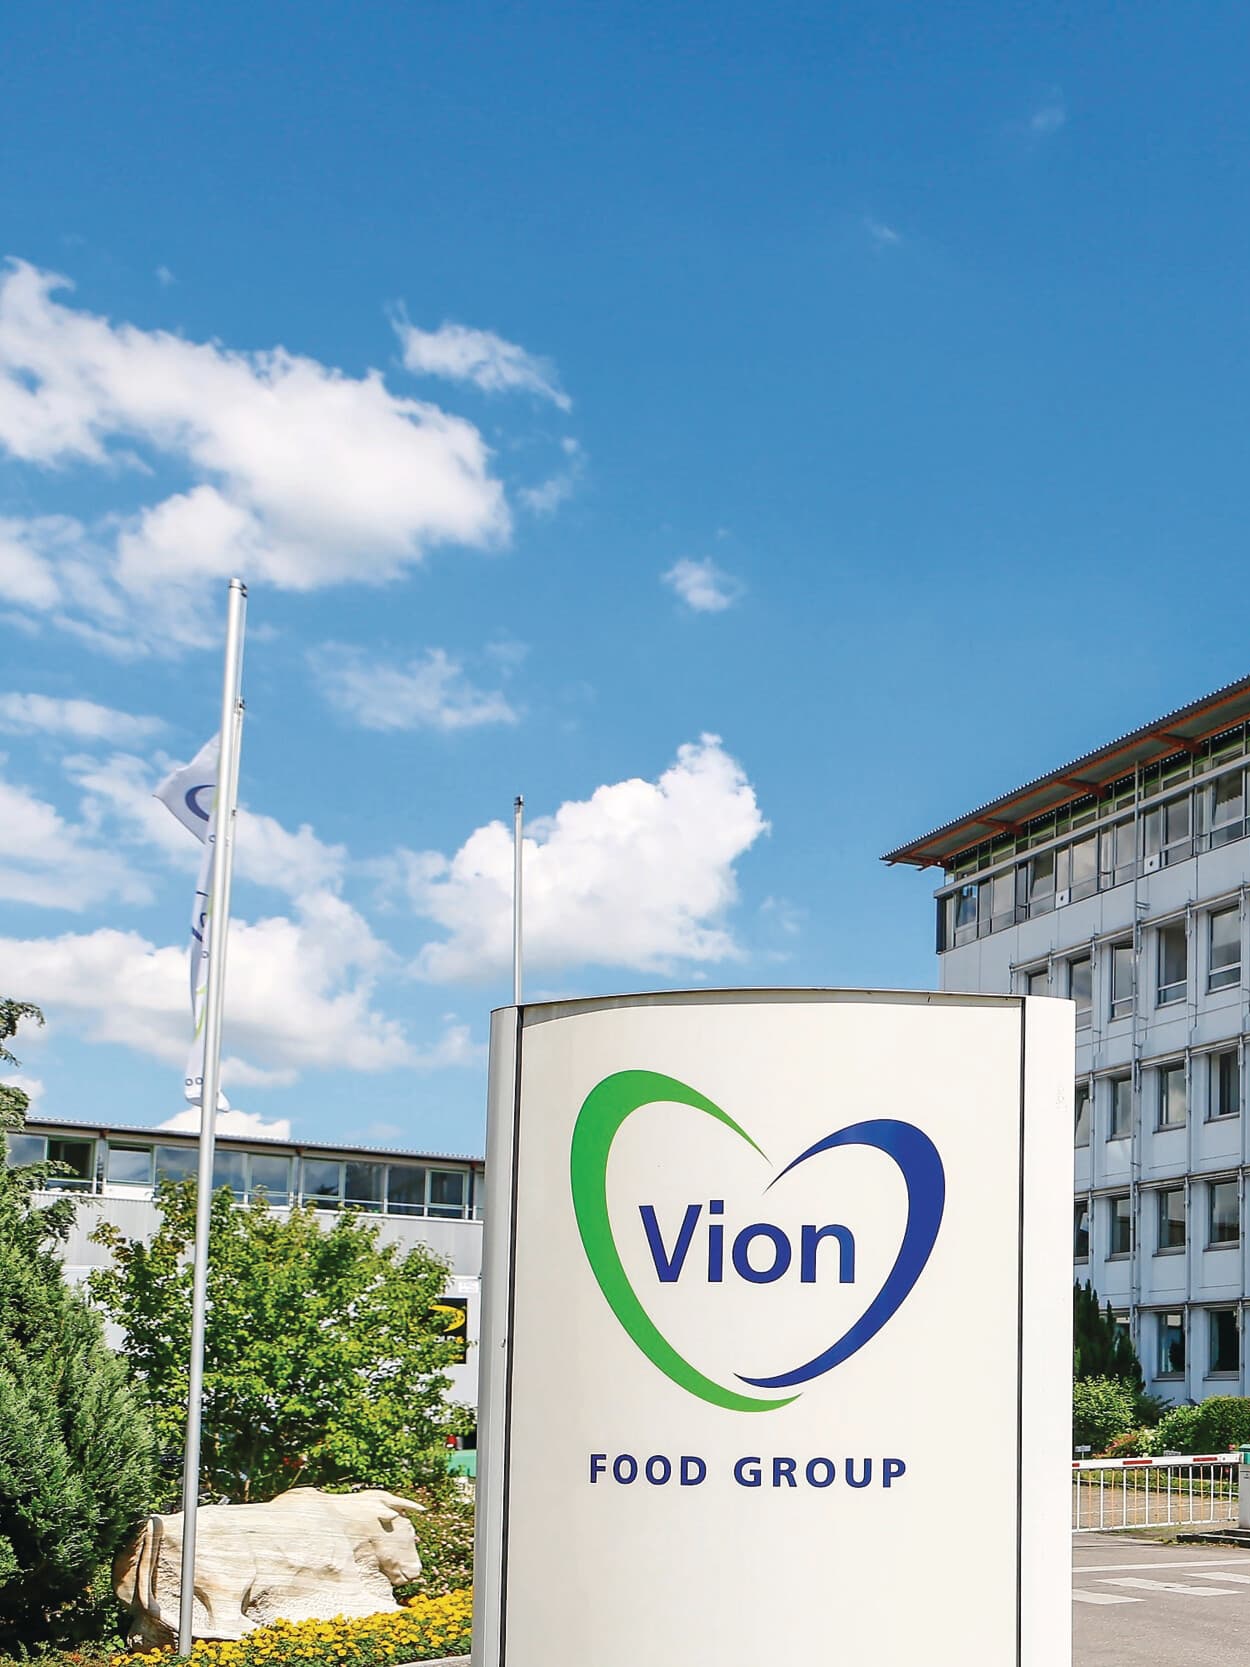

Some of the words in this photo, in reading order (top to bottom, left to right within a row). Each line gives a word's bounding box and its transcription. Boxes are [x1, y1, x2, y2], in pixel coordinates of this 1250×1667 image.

[639, 1200, 855, 1284] Vion
[590, 1454, 707, 1486] FOOD
[734, 1456, 906, 1488] GROUP
